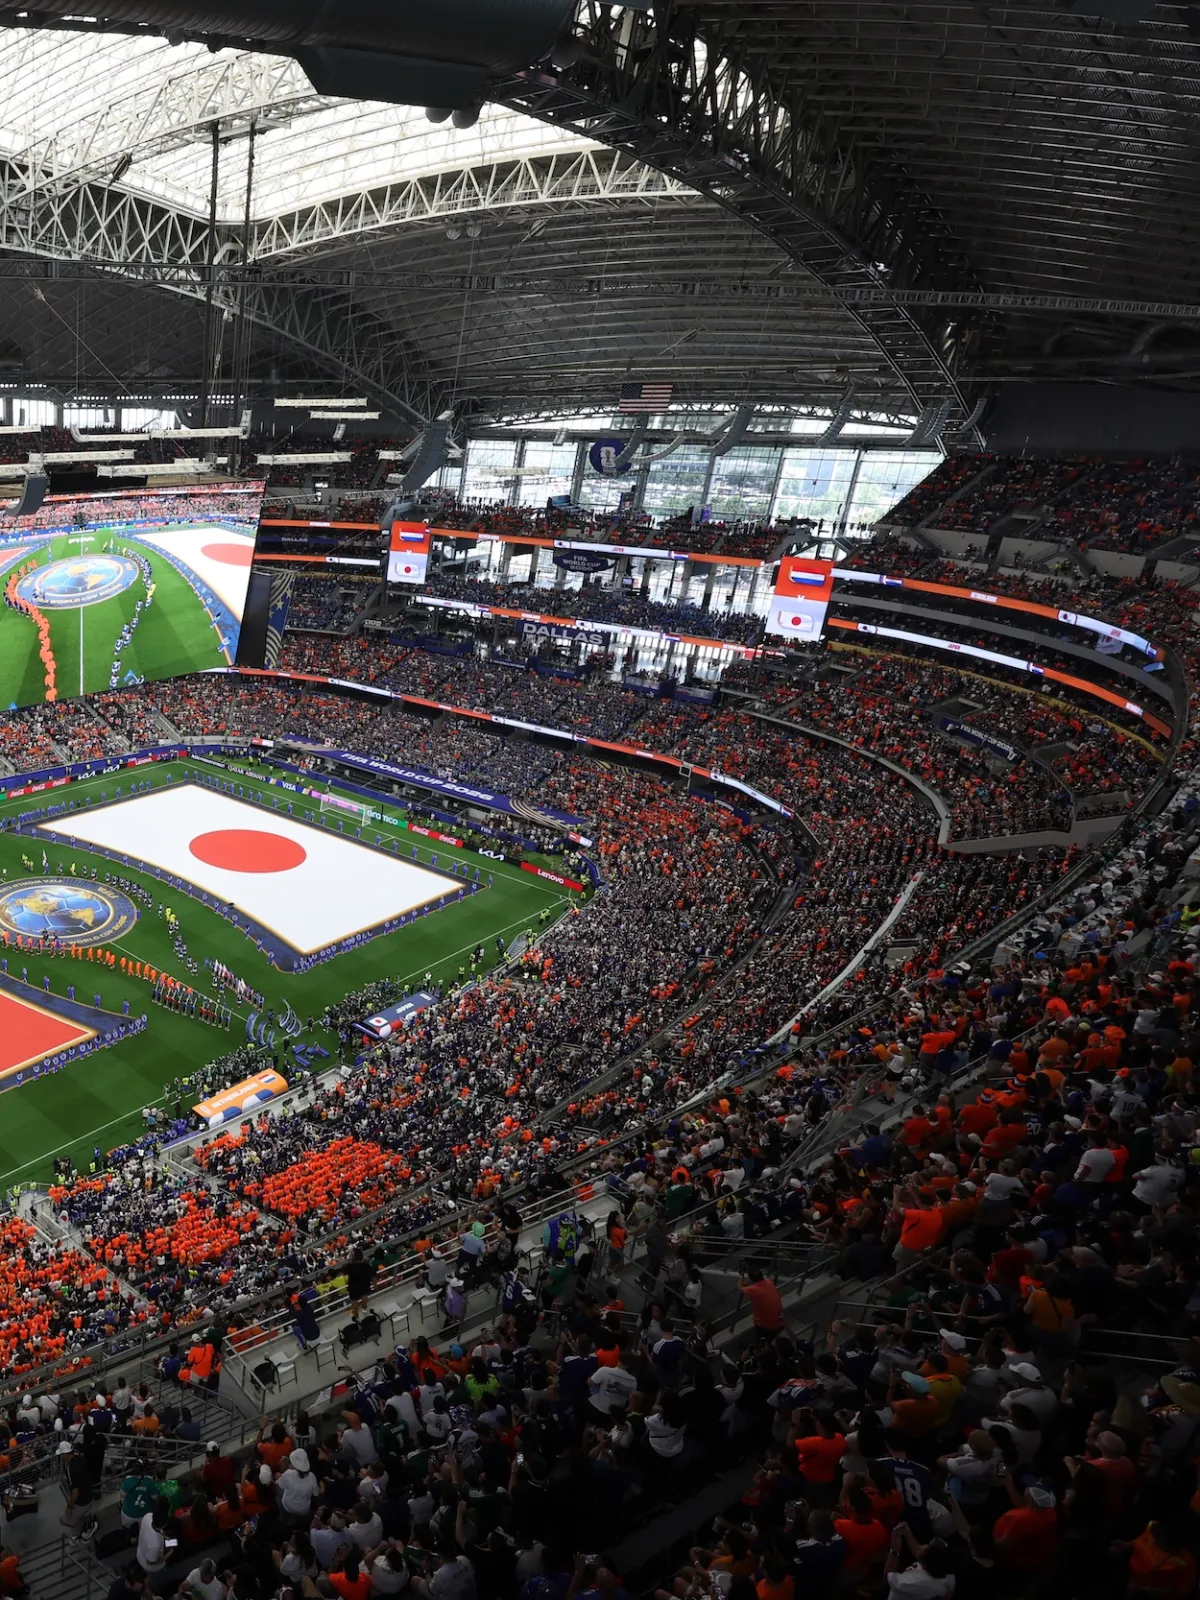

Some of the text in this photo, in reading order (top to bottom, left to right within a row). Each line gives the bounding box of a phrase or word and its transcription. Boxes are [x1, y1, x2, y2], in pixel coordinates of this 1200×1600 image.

[523, 623, 603, 645] DALLAS
[341, 752, 494, 801] FIFA WORLD CUP 2026
[281, 781, 297, 792] VISA
[537, 868, 564, 884] Lenovo
[211, 1082, 259, 1109] NETHERLANDS
[1123, 1101, 1135, 1112] 10
[1027, 1121, 1041, 1136] 20
